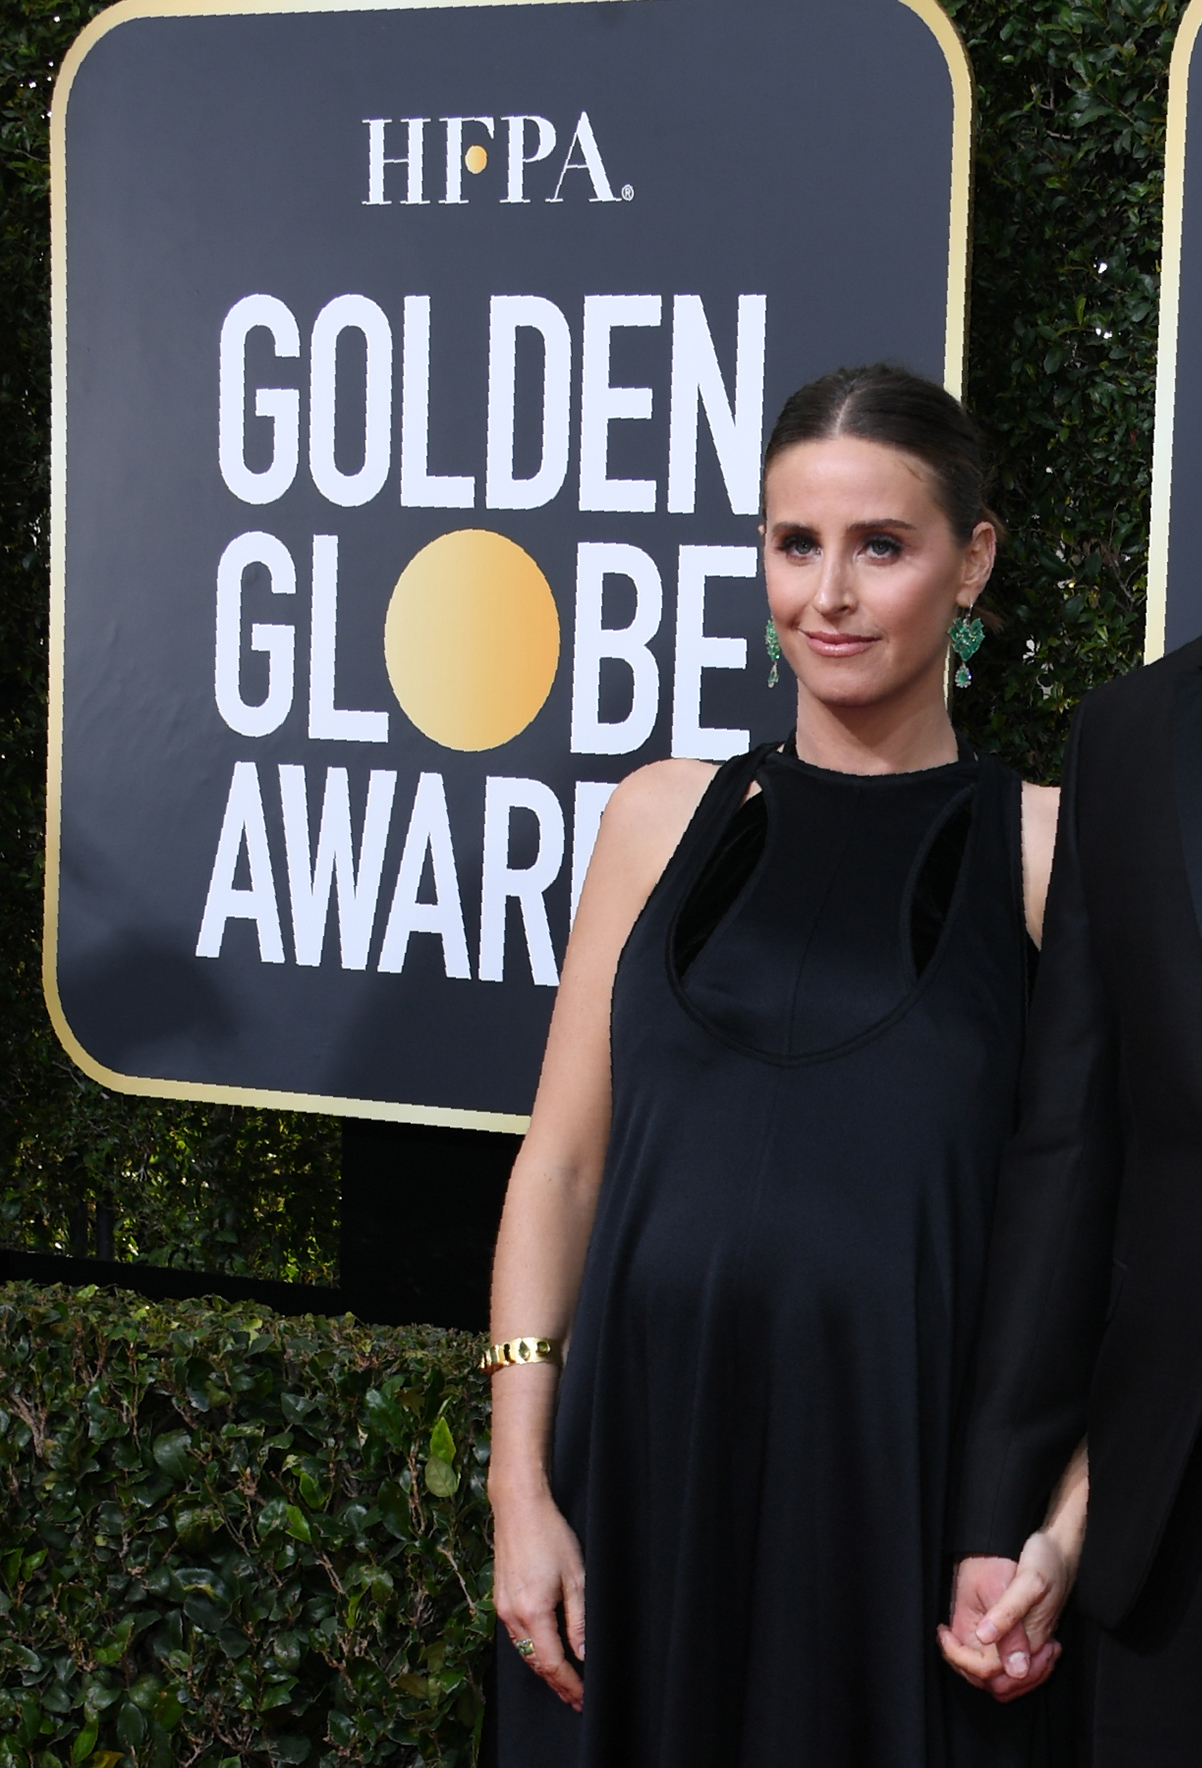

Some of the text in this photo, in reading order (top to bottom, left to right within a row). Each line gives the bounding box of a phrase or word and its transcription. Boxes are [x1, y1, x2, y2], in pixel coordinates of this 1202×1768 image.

[218, 293, 767, 515] GOLDEN
[214, 529, 758, 761] GLOBE
[195, 761, 620, 987] AWAR
